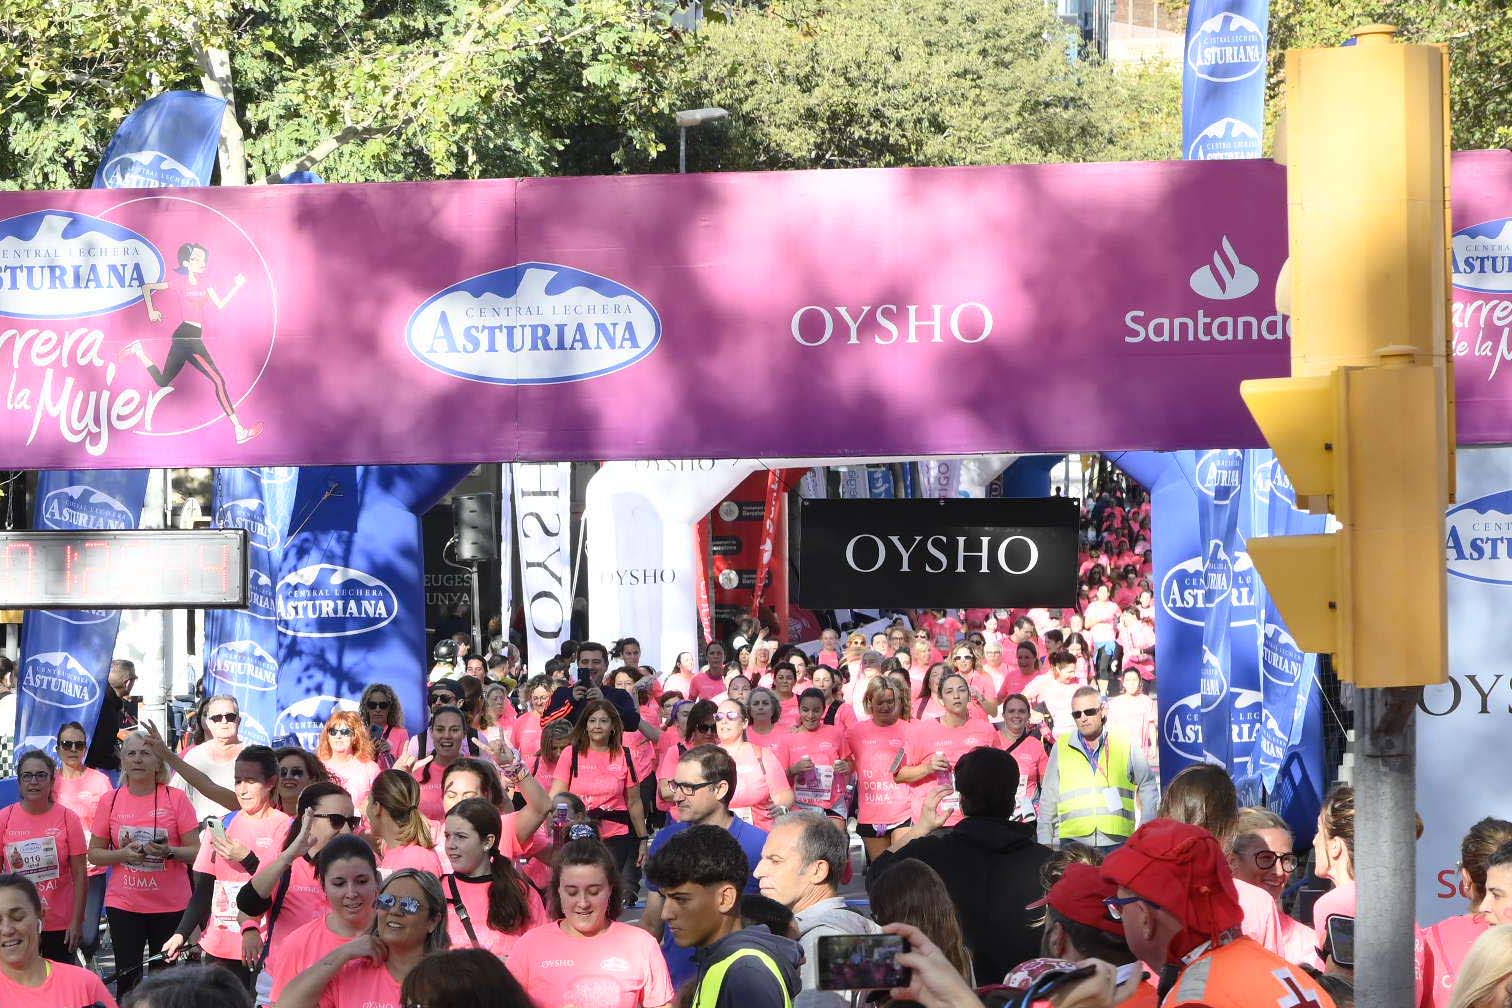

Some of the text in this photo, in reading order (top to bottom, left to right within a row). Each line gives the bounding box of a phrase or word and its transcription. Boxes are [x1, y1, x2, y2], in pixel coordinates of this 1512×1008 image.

[1196, 40, 1259, 66] ASTURIANA
[465, 303, 633, 317] CENTRAL LECHERA
[792, 302, 993, 346] OYSHO
[1124, 310, 1292, 343] Santand
[427, 310, 641, 354] ASTURIANA
[7, 371, 31, 410] la
[26, 363, 175, 456] Mujer
[1472, 522, 1512, 531] CENT
[845, 534, 1039, 575] OYSHO
[424, 574, 472, 586] EUGES
[601, 569, 677, 586] OYSHO
[289, 588, 384, 597] CENTRAL LECHERA
[426, 593, 471, 605] UNYA
[277, 594, 388, 621] ASTURIANA
[289, 721, 324, 730] CENTRA
[863, 770, 873, 778] TU
[864, 783, 900, 791] DORSAL
[864, 794, 890, 802] SUMA
[24, 854, 41, 865] 016
[123, 874, 158, 888] SUMA
[542, 959, 574, 969] OYSHO
